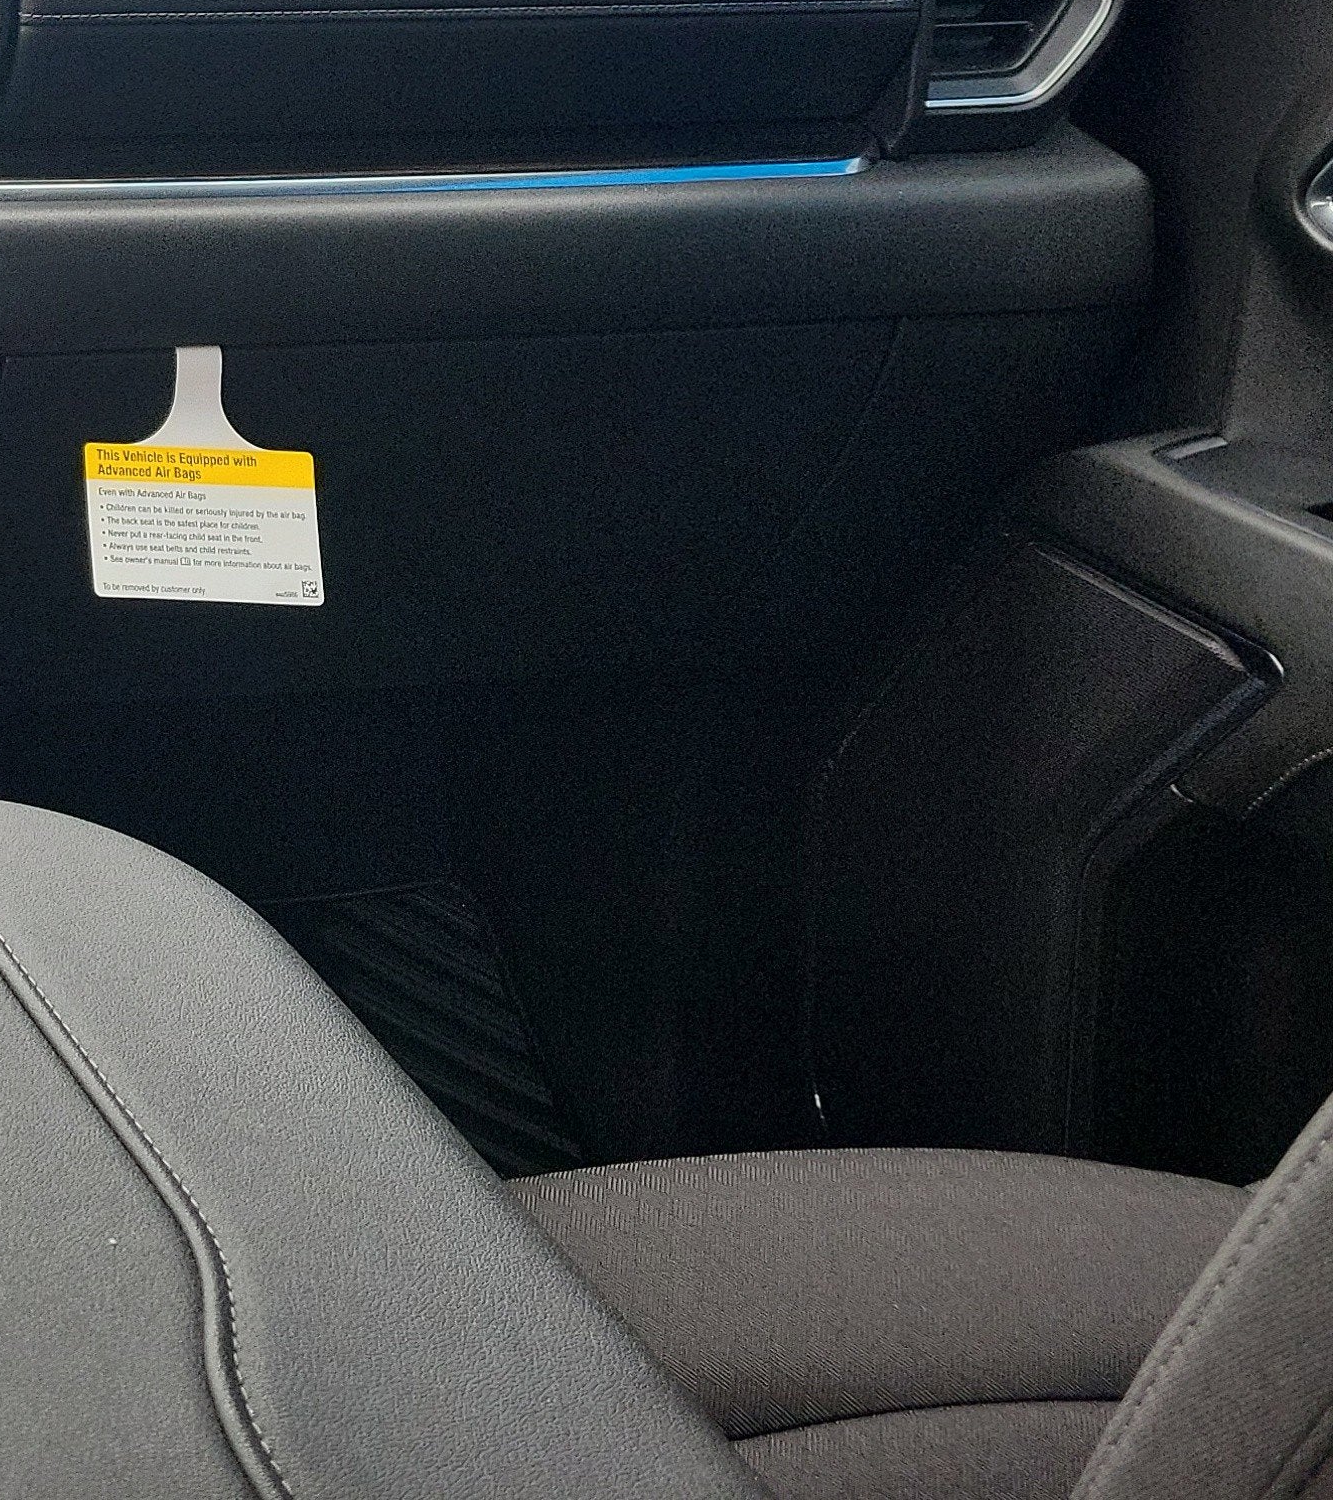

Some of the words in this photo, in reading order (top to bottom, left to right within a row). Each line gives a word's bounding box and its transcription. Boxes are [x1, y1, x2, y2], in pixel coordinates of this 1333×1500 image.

[97, 449, 120, 461] This
[123, 450, 163, 463] Vehicle
[167, 452, 176, 463] is
[179, 452, 230, 469] Equipped
[233, 454, 257, 467] with
[98, 464, 152, 477] Advanced
[155, 466, 171, 478] Air
[174, 467, 202, 482] Bags
[98, 487, 117, 496] Even
[118, 488, 135, 497] with
[137, 488, 173, 499] Advanced
[175, 490, 186, 500] Air
[188, 491, 206, 501] Bags
[106, 503, 137, 513] Children
[154, 505, 163, 513] be
[164, 505, 183, 514] killed
[195, 508, 227, 517] seriously
[229, 509, 253, 518] injured
[256, 509, 264, 519] by
[267, 510, 278, 518] the
[281, 511, 290, 519] air
[107, 516, 119, 524] The
[165, 519, 175, 527] the
[200, 521, 218, 529] place
[220, 521, 229, 529] for
[108, 529, 128, 537] Never
[130, 531, 141, 539] put
[149, 532, 187, 541] rear-facing
[189, 533, 205, 541] child
[109, 542, 133, 551] Always
[199, 546, 215, 554] child
[223, 560, 261, 569] information
[263, 562, 282, 570] about
[122, 584, 149, 592] removed
[151, 584, 159, 593] by
[161, 585, 190, 593] customer
